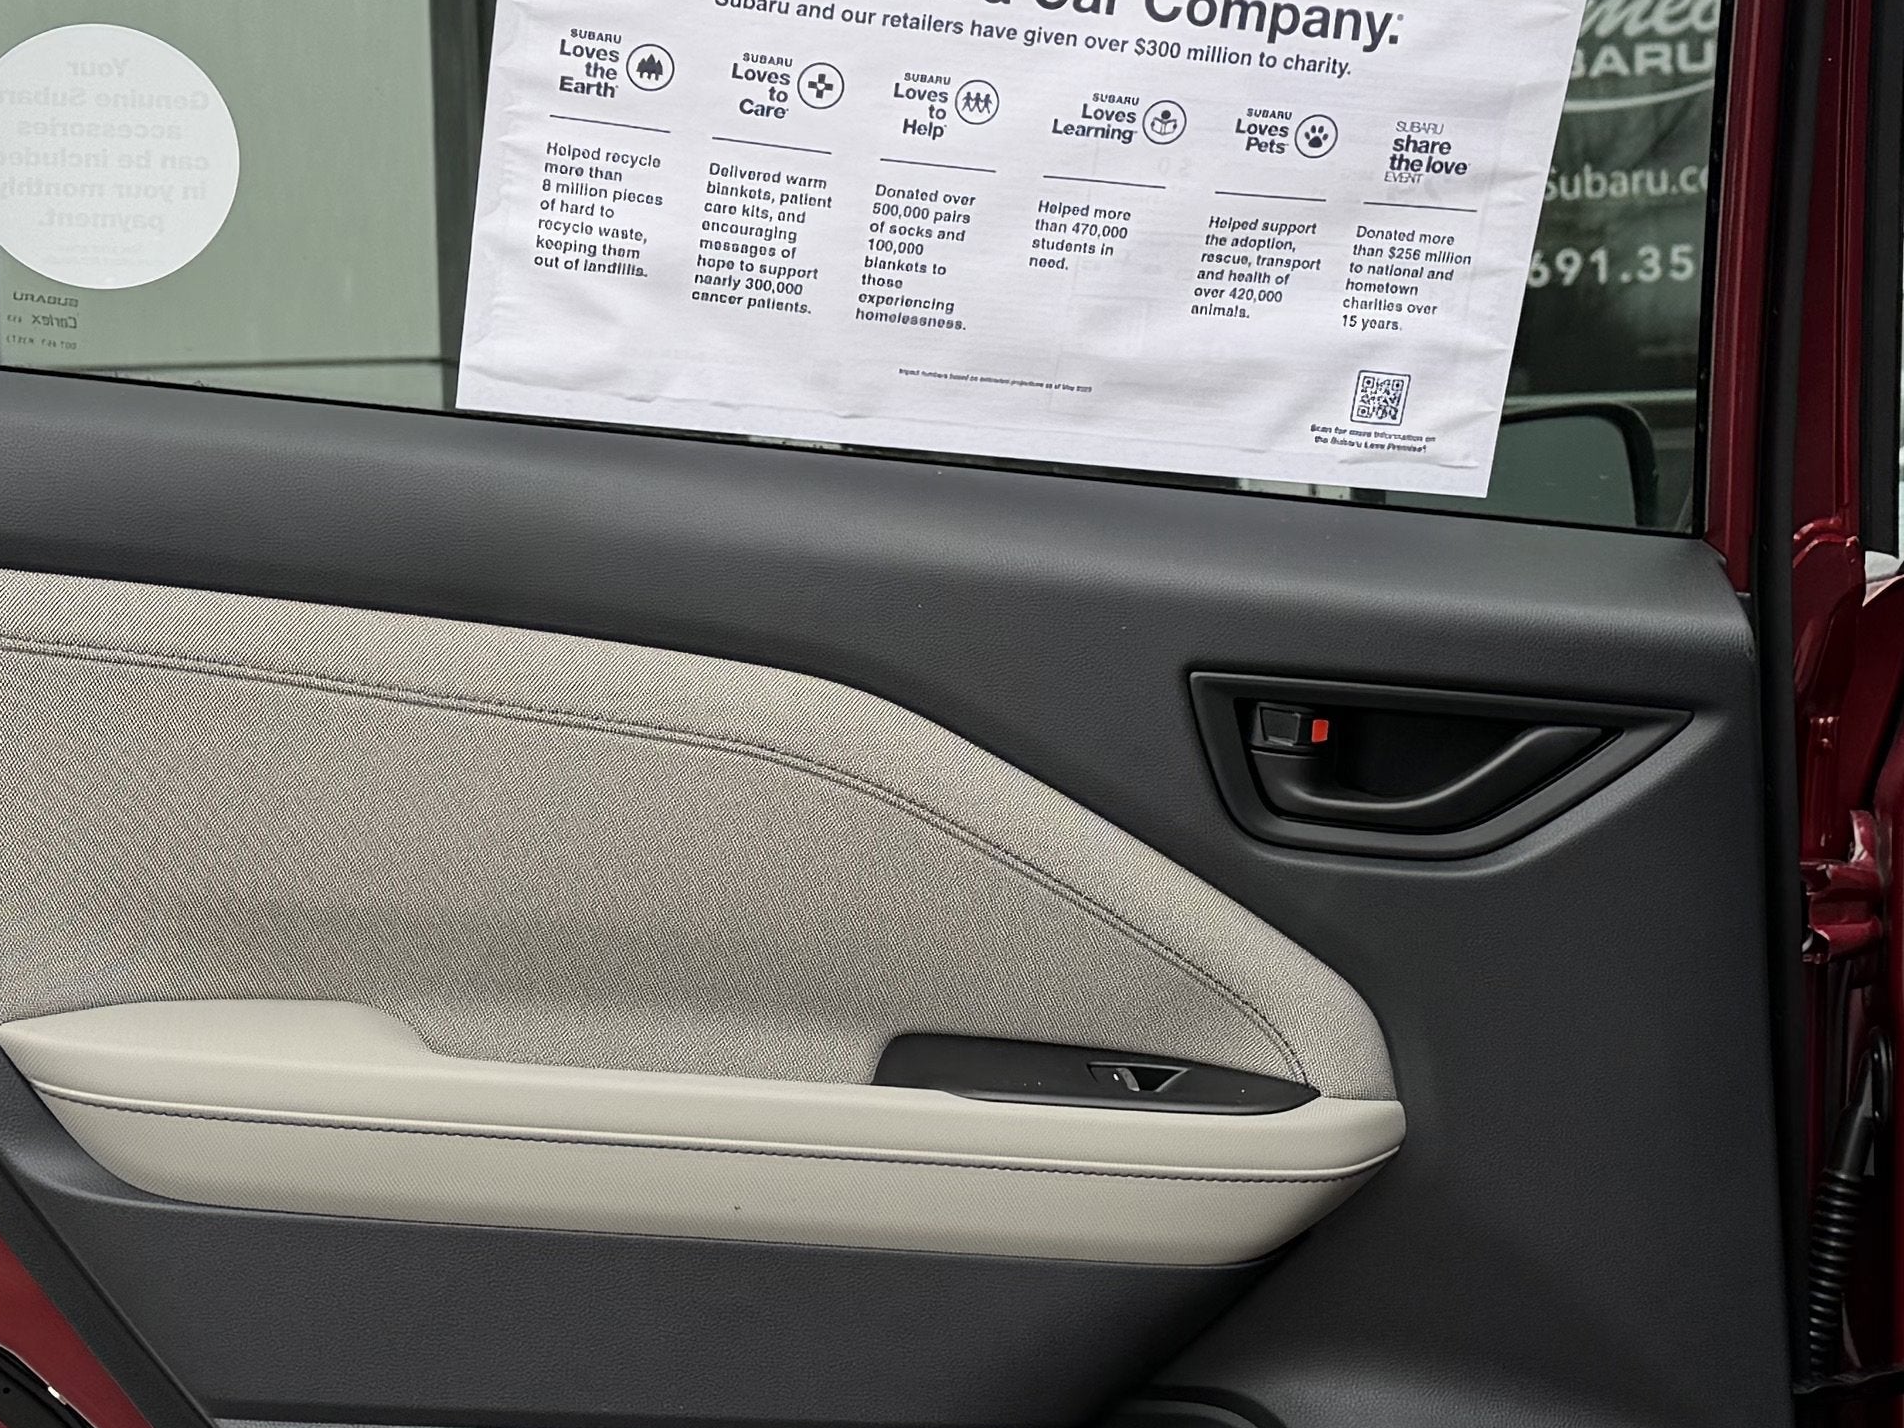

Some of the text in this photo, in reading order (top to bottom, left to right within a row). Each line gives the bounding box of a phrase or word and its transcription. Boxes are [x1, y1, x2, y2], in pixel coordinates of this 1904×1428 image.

[569, 26, 623, 46] SUBARU
[794, 1, 837, 22] and
[839, 7, 879, 26] our
[880, 11, 965, 36] retailers
[968, 18, 1019, 42] have
[1021, 24, 1079, 49] given
[1082, 34, 1131, 54] over
[1132, 36, 1183, 60] $300
[1185, 43, 1254, 68] million
[1257, 50, 1279, 70] to
[1281, 52, 1353, 81] charity.
[558, 37, 621, 65] Loves
[741, 50, 794, 69] SUBARU
[583, 60, 619, 82] the
[730, 61, 792, 87] Loves
[902, 71, 953, 87] SUBARU
[767, 84, 790, 105] to
[892, 81, 950, 105] Loves
[1091, 91, 1141, 108] SUBARU
[926, 102, 948, 122] to
[1080, 101, 1138, 126] Loves
[1244, 106, 1294, 122] SUBARU
[1233, 116, 1291, 139] Loves
[1394, 119, 1446, 137] SUBARU
[545, 140, 662, 170] Helped recycle
[1390, 132, 1454, 158] share
[543, 161, 624, 184] more than
[1387, 151, 1426, 174] the
[708, 161, 829, 191] Delivered warm
[1382, 168, 1426, 188] EVENT
[540, 177, 665, 208] 8 million pieces
[705, 179, 834, 210] blankets, patient
[873, 182, 978, 208] Donated over
[538, 196, 616, 220] of hard to
[702, 201, 808, 225] care kits, and
[871, 200, 972, 226] 500,000 pairs
[1036, 198, 1133, 223] Helped more
[536, 217, 649, 246] recycle waste,
[700, 218, 799, 246] encouraging
[868, 219, 968, 243] of socks and
[1033, 217, 1130, 241] than 470,000
[1207, 214, 1319, 238] Helped support
[1354, 223, 1456, 247] Donated more
[534, 233, 642, 261] keeping them
[698, 237, 798, 261] messages of
[867, 236, 926, 257] 100,000
[1030, 235, 1115, 258] students in
[1203, 232, 1297, 255] the adoption,
[1351, 242, 1473, 267] than $256 million
[532, 254, 561, 271] out
[562, 256, 581, 272] of
[695, 252, 820, 281] hope to support
[862, 253, 948, 277] blankets to
[1027, 255, 1070, 272] need.
[1199, 251, 1323, 273] rescue, transport
[1348, 260, 1456, 283] to national and
[693, 272, 805, 297] nearly 300,000
[860, 271, 905, 291] those
[1195, 267, 1292, 287] and health of
[1344, 276, 1420, 298] hometown
[690, 289, 813, 316] cancer patients.
[856, 291, 956, 317] experiencing
[1192, 285, 1284, 305] over 420,000
[1341, 294, 1439, 317] charities over
[854, 306, 967, 332] homelessness.
[1189, 301, 1251, 320] animals.
[1341, 313, 1404, 333] 15 years.
